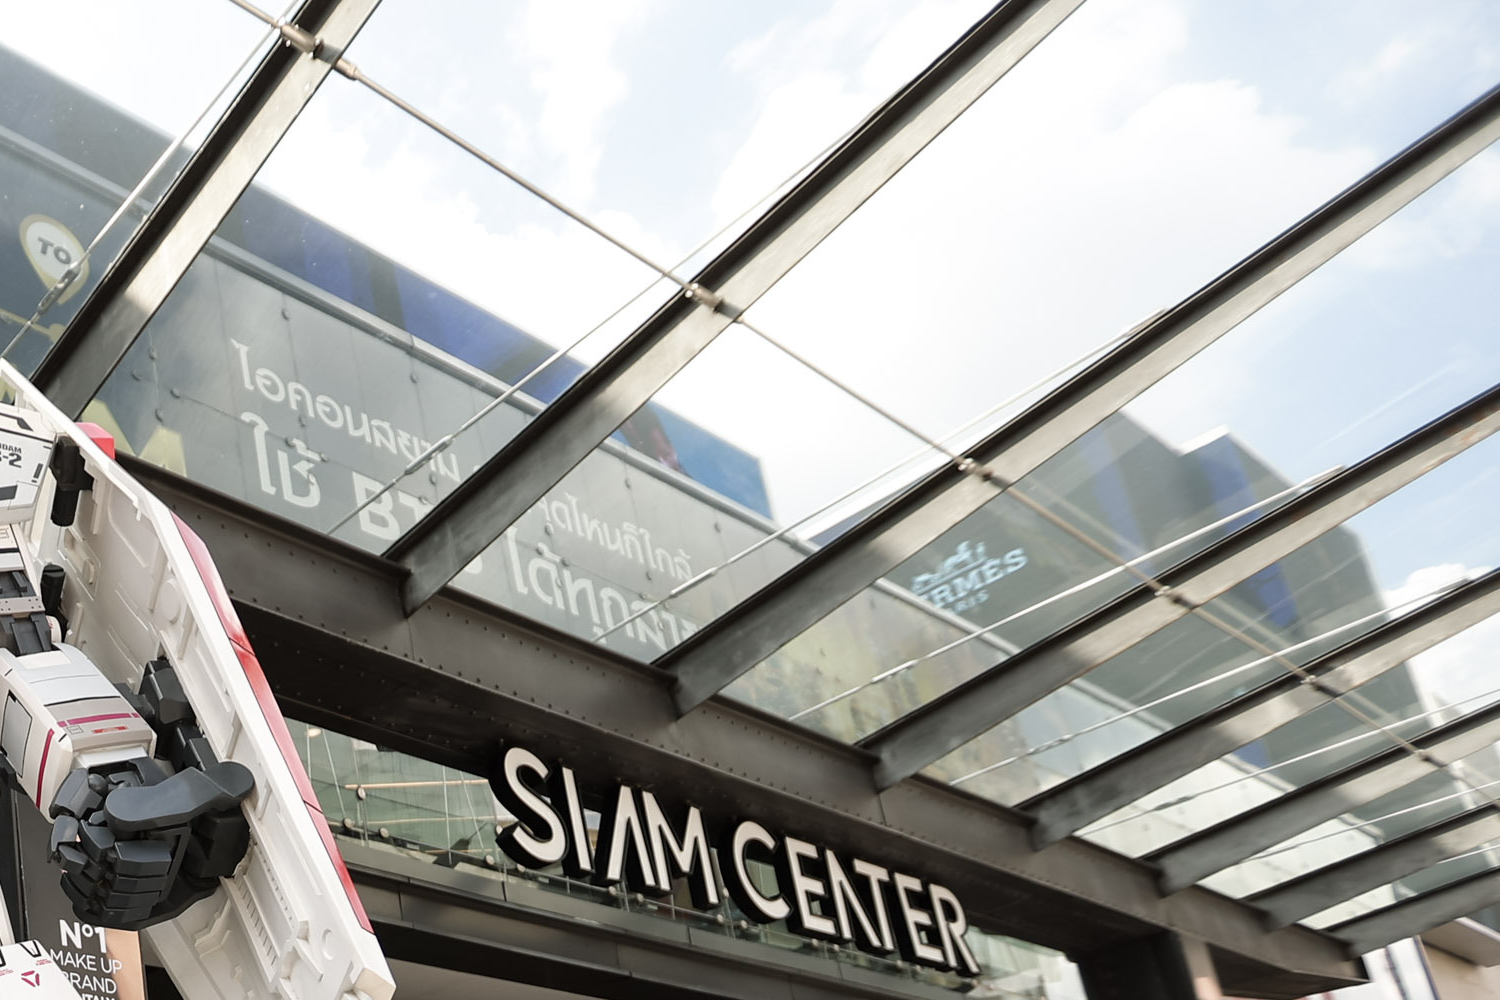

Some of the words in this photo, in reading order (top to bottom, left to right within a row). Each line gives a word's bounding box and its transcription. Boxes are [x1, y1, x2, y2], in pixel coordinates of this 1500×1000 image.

[36, 236, 72, 265] TO
[498, 746, 720, 906] SIAM
[731, 820, 981, 975] CENTER
[50, 948, 98, 972] MAKE
[100, 957, 123, 975] UP
